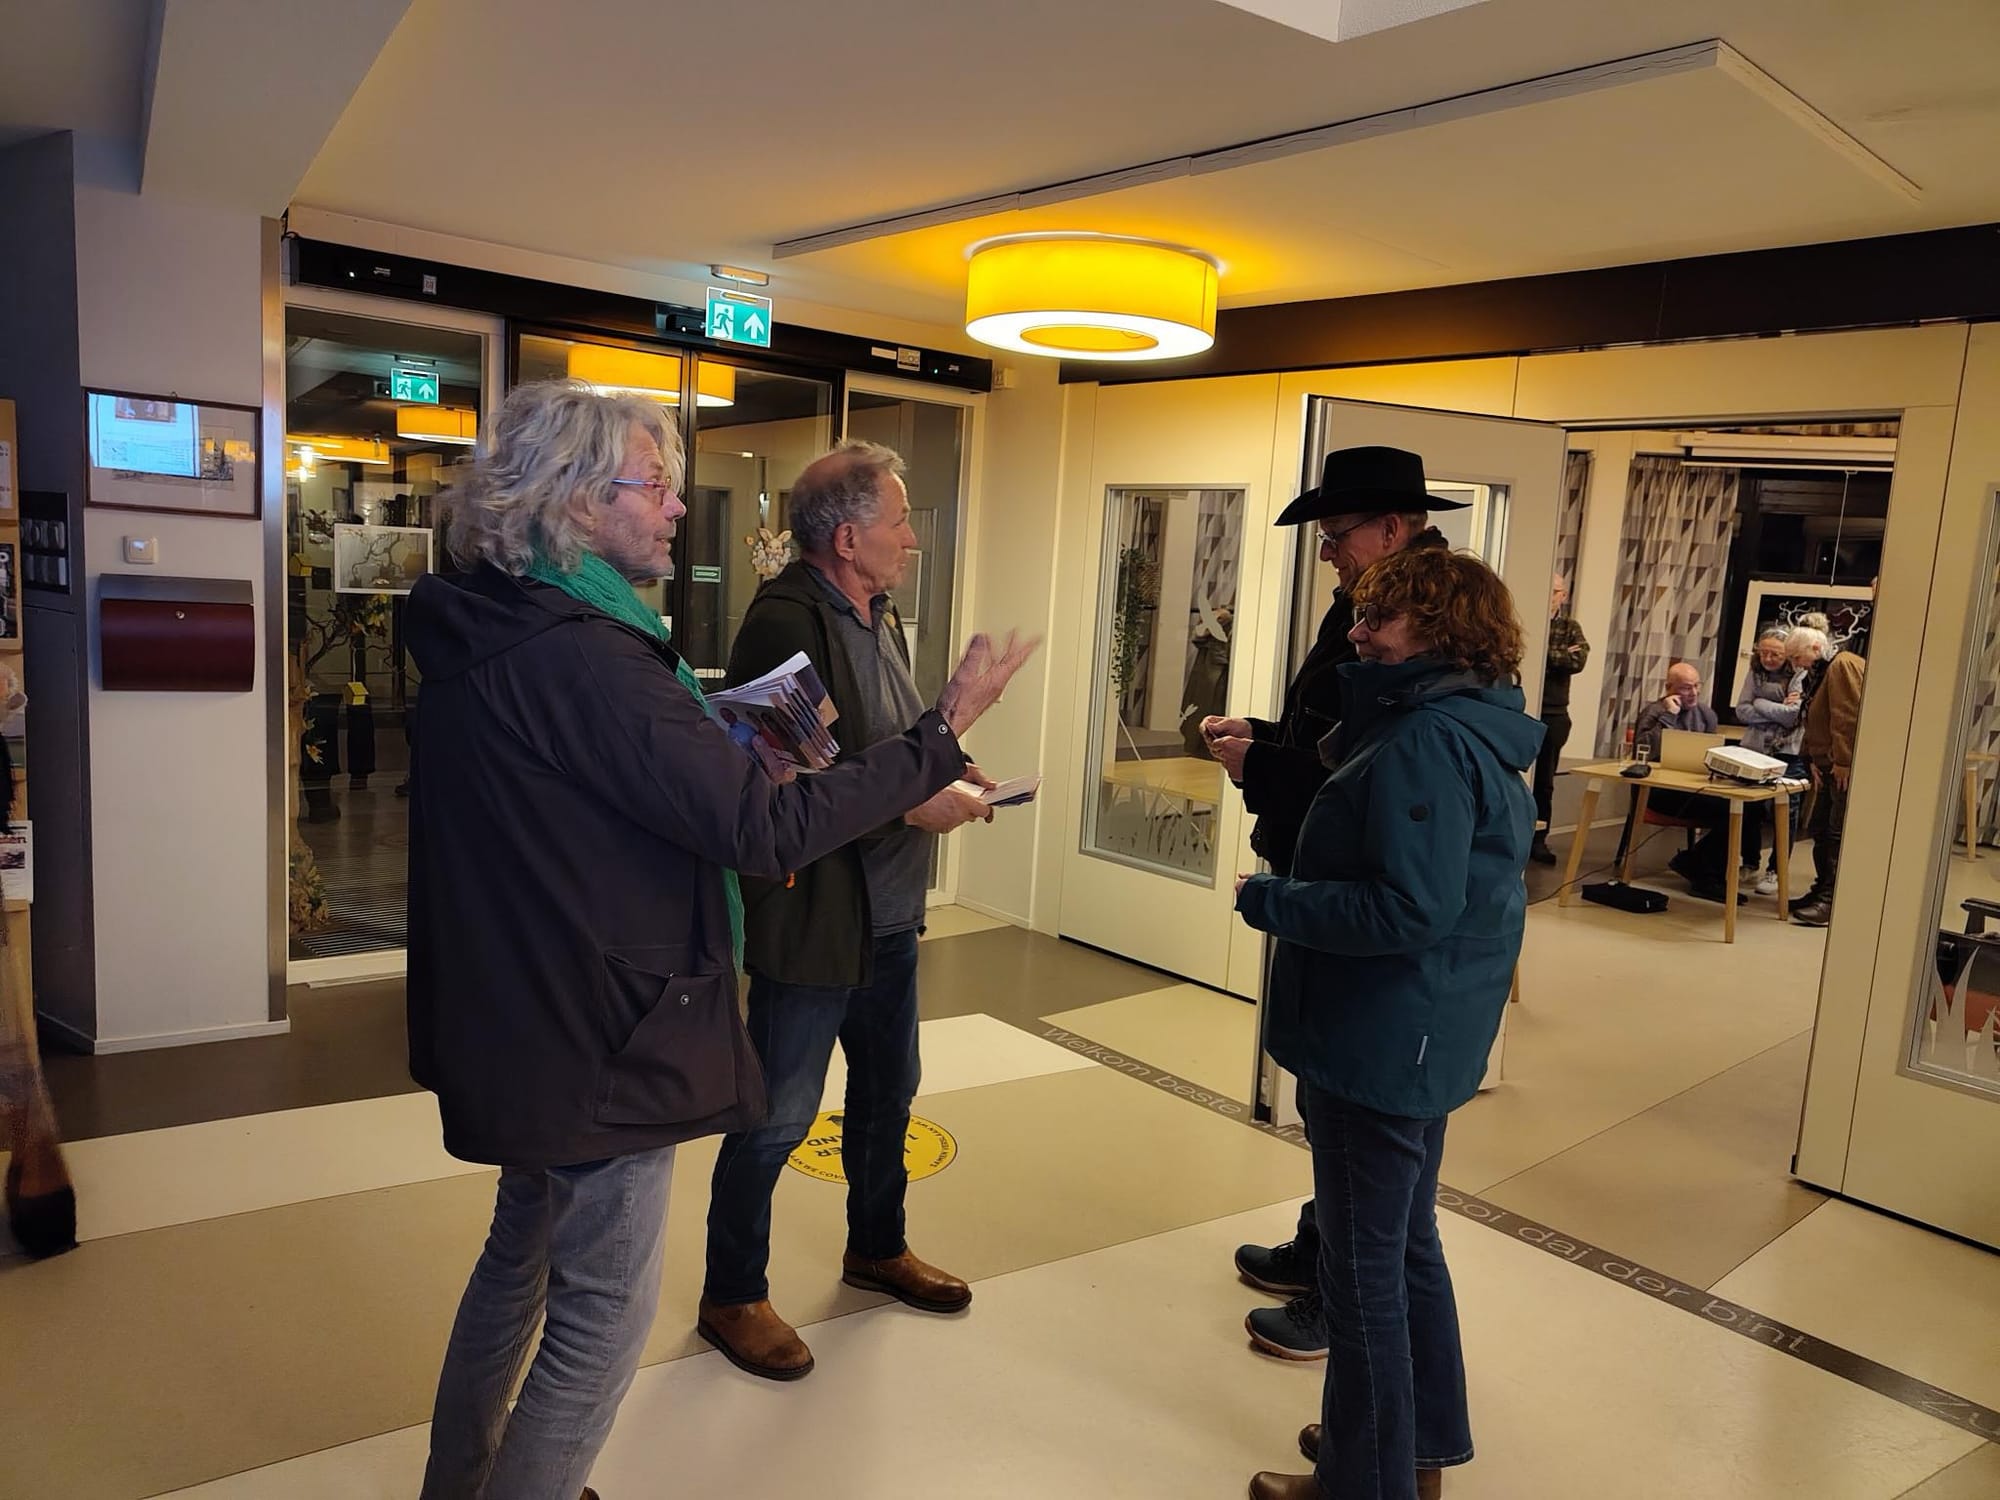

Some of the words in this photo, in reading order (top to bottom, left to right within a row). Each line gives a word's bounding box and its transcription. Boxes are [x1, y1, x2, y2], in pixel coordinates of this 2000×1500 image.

[1042, 1027, 1151, 1077] Welkom
[1155, 1070, 1242, 1115] beste
[816, 1148, 842, 1158] ER
[820, 1170, 847, 1182] COVI
[1436, 1187, 1507, 1222] ooi
[1517, 1225, 1594, 1262] daj
[1601, 1257, 1692, 1299] der
[1700, 1299, 1806, 1355] bint
